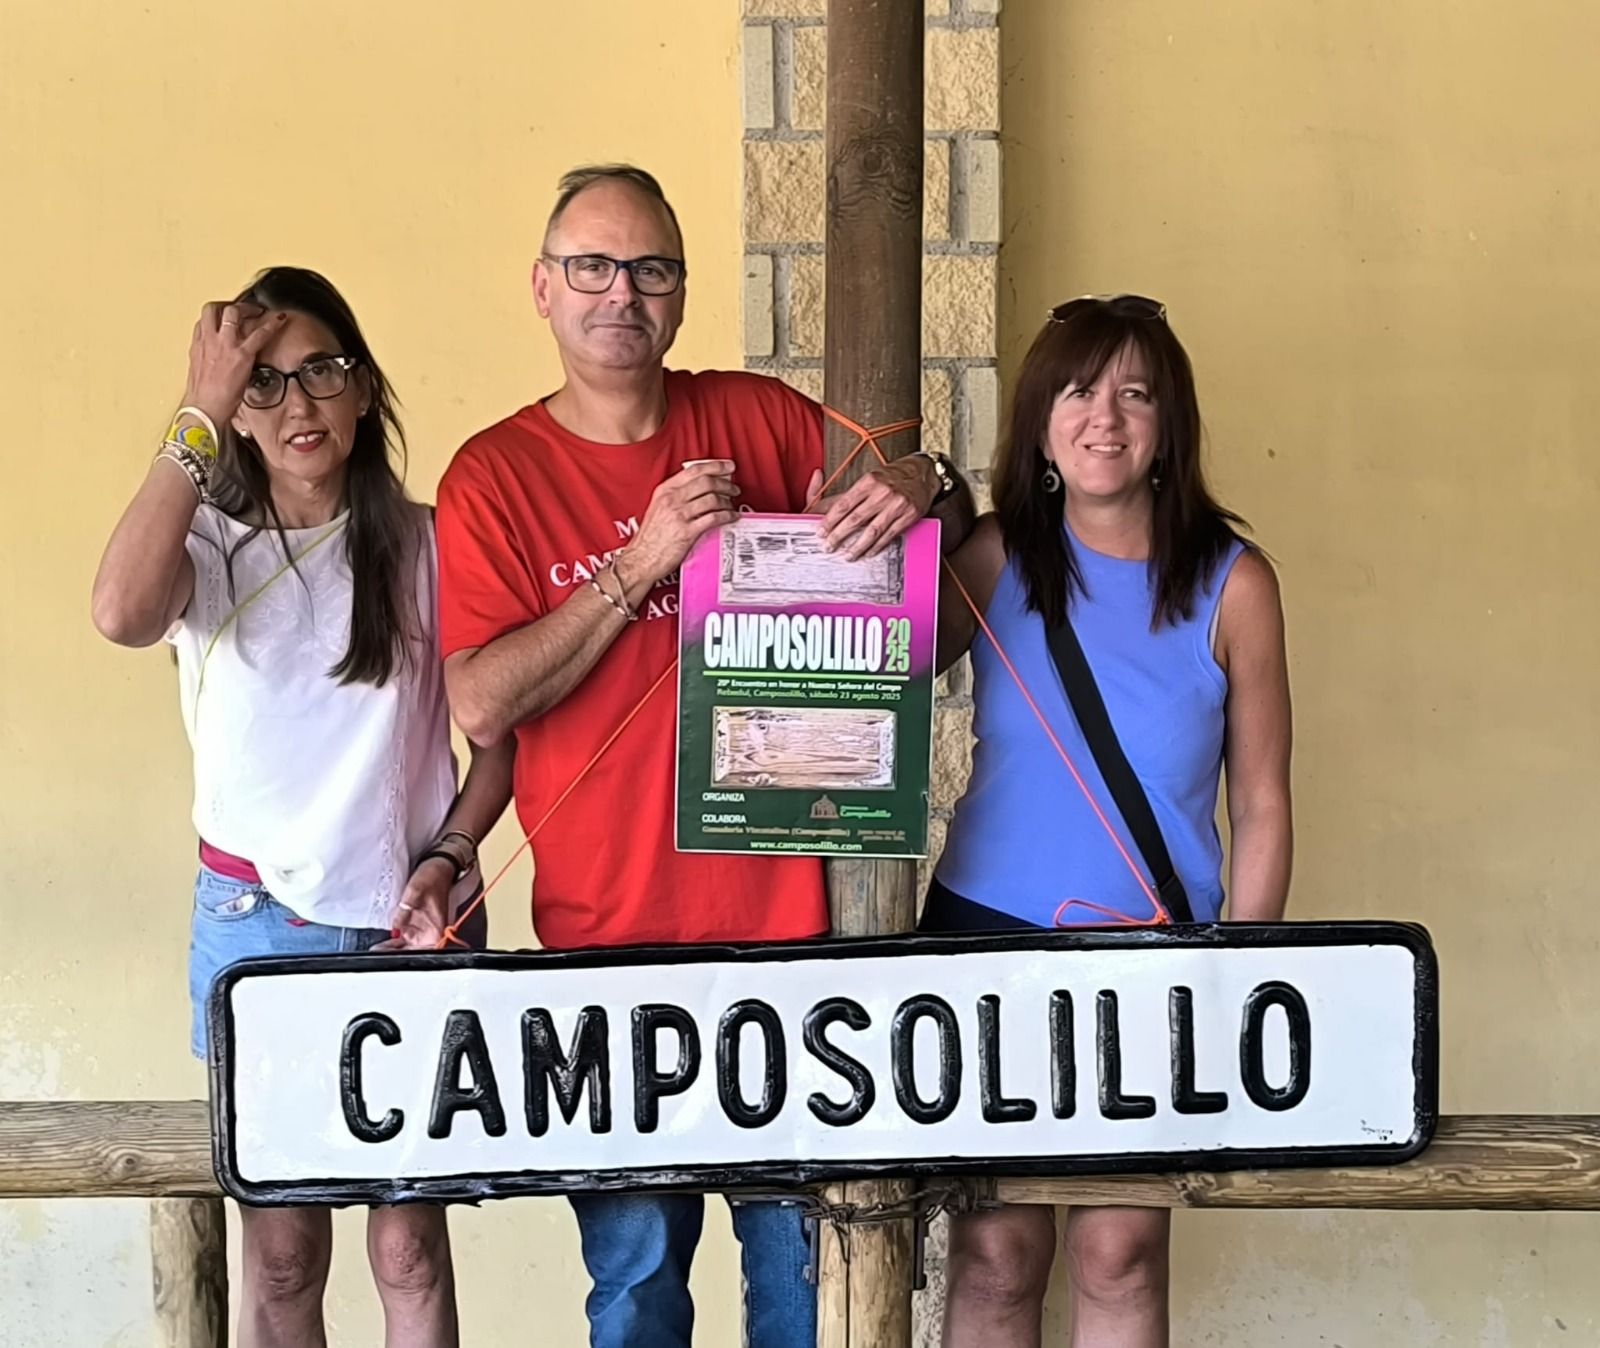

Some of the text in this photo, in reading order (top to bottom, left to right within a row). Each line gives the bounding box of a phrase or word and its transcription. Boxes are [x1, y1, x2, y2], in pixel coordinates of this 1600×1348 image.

[549, 547, 625, 587] CAM
[704, 611, 883, 672] CAMPOSOLILLO
[885, 617, 911, 645] 20
[884, 645, 910, 672] 25
[702, 792, 745, 802] ORGANIZA
[702, 814, 747, 824] COLABORA
[750, 841, 862, 852] www.camposolillo.com
[339, 980, 1311, 1143] CAMPOSOLILLO
